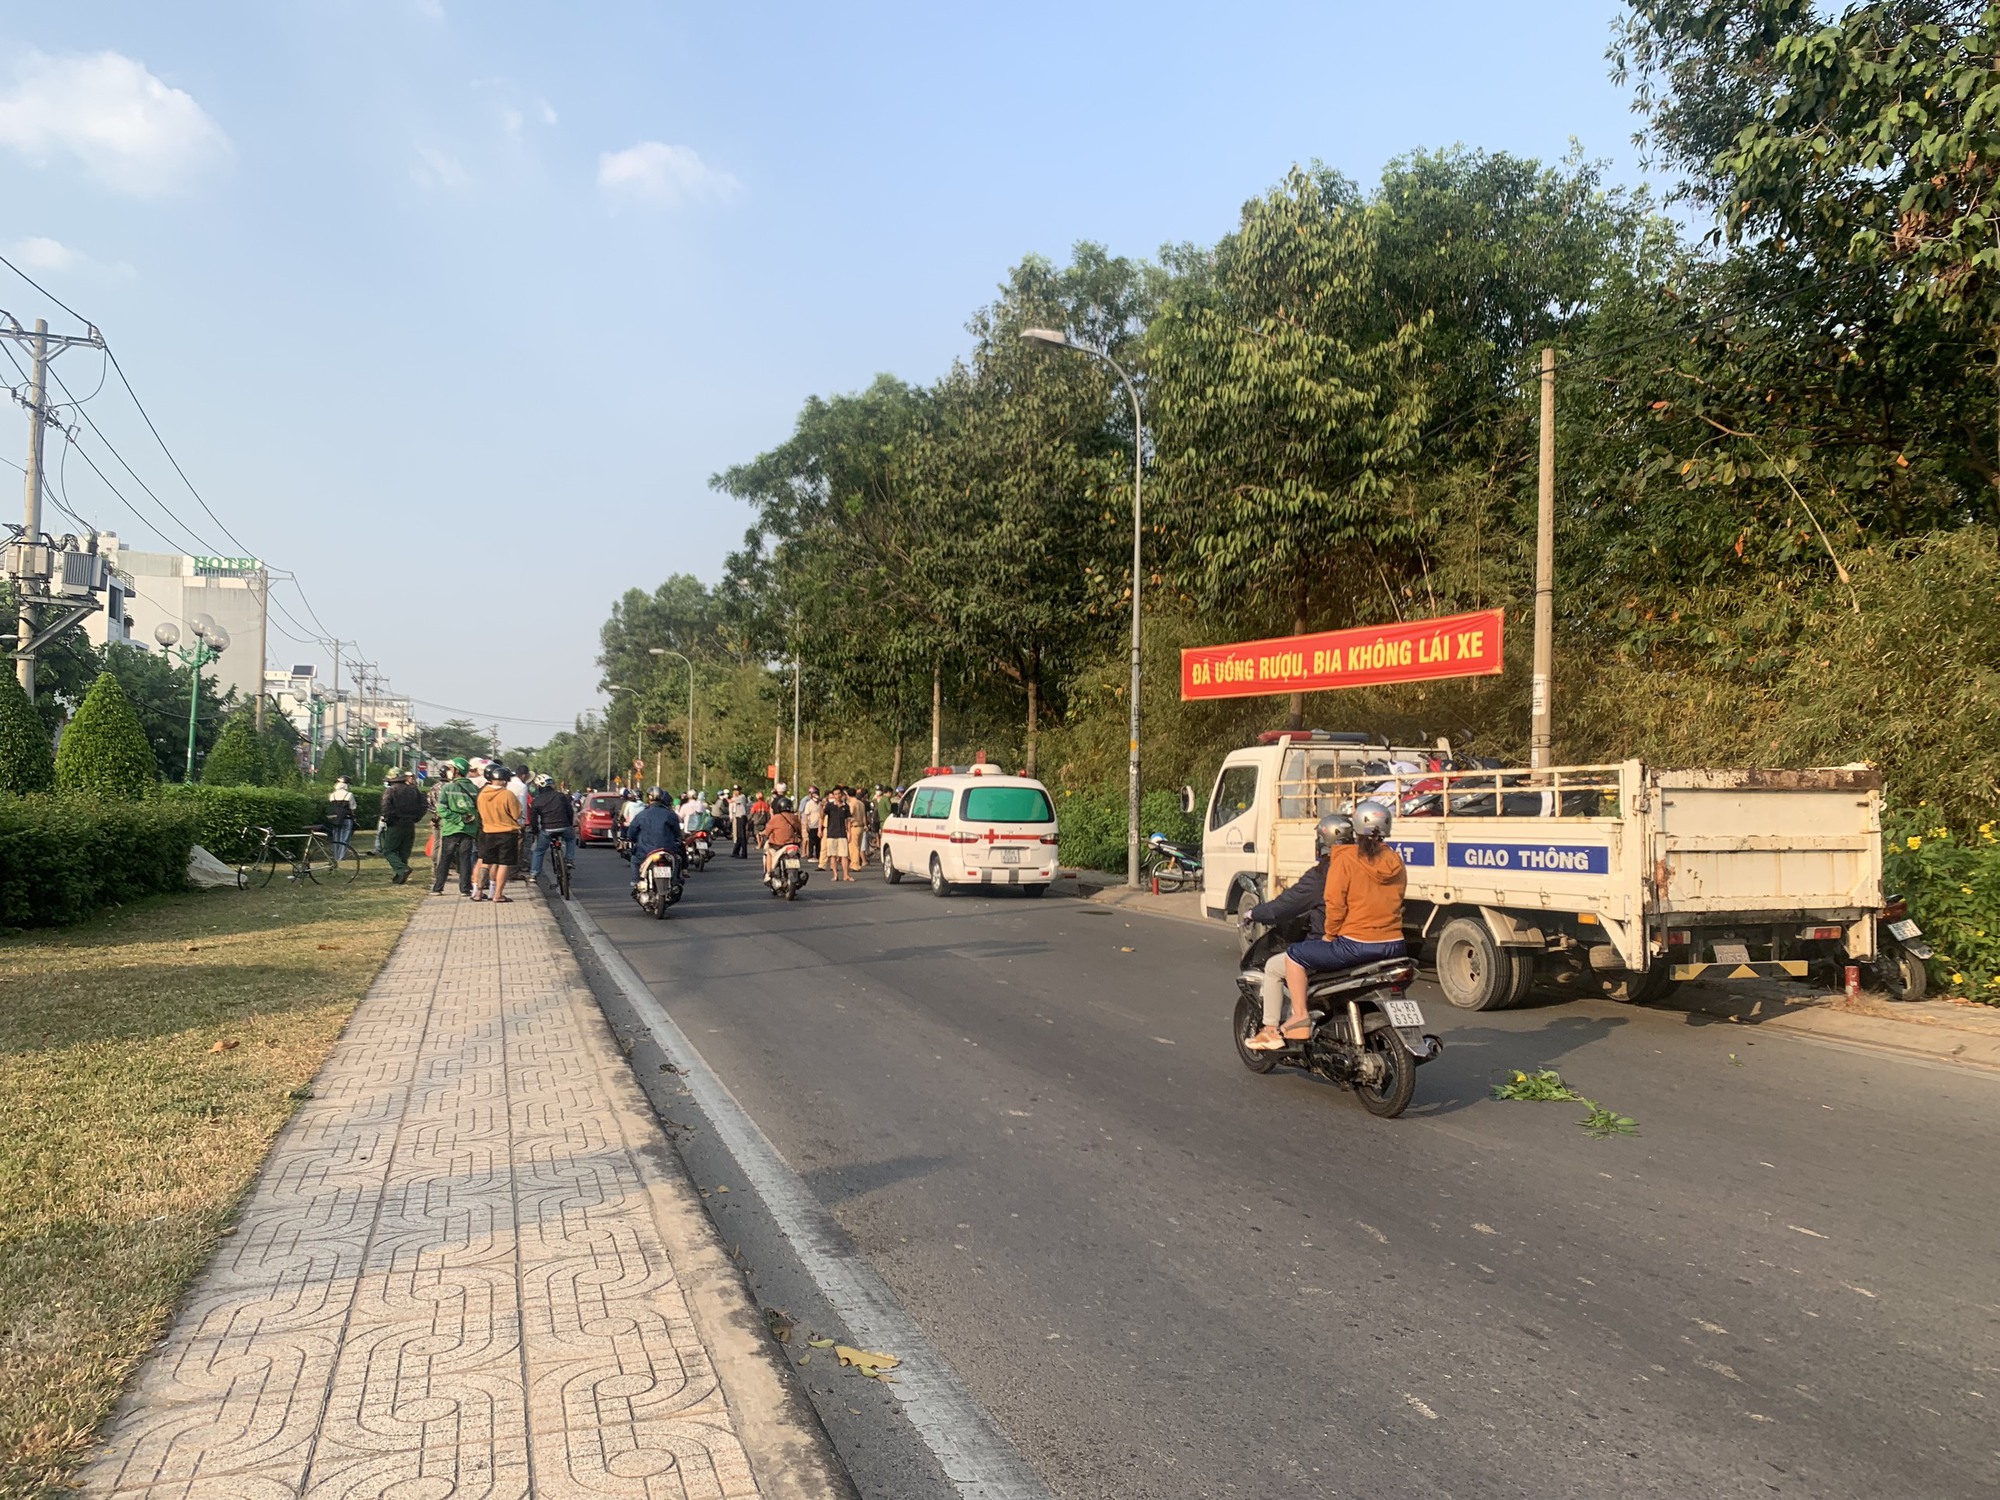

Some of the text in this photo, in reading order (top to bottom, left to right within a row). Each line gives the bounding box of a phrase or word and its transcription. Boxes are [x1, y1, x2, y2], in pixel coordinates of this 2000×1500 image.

[193, 555, 262, 570] HOTEL
[1192, 630, 1484, 685] ĐÃ UỐNG RƯỢU, BIA KHÔNG LÁI XE
[1395, 843, 1589, 870] ÁT GIAO THÔNG
[1394, 1014, 1421, 1025] 6353
